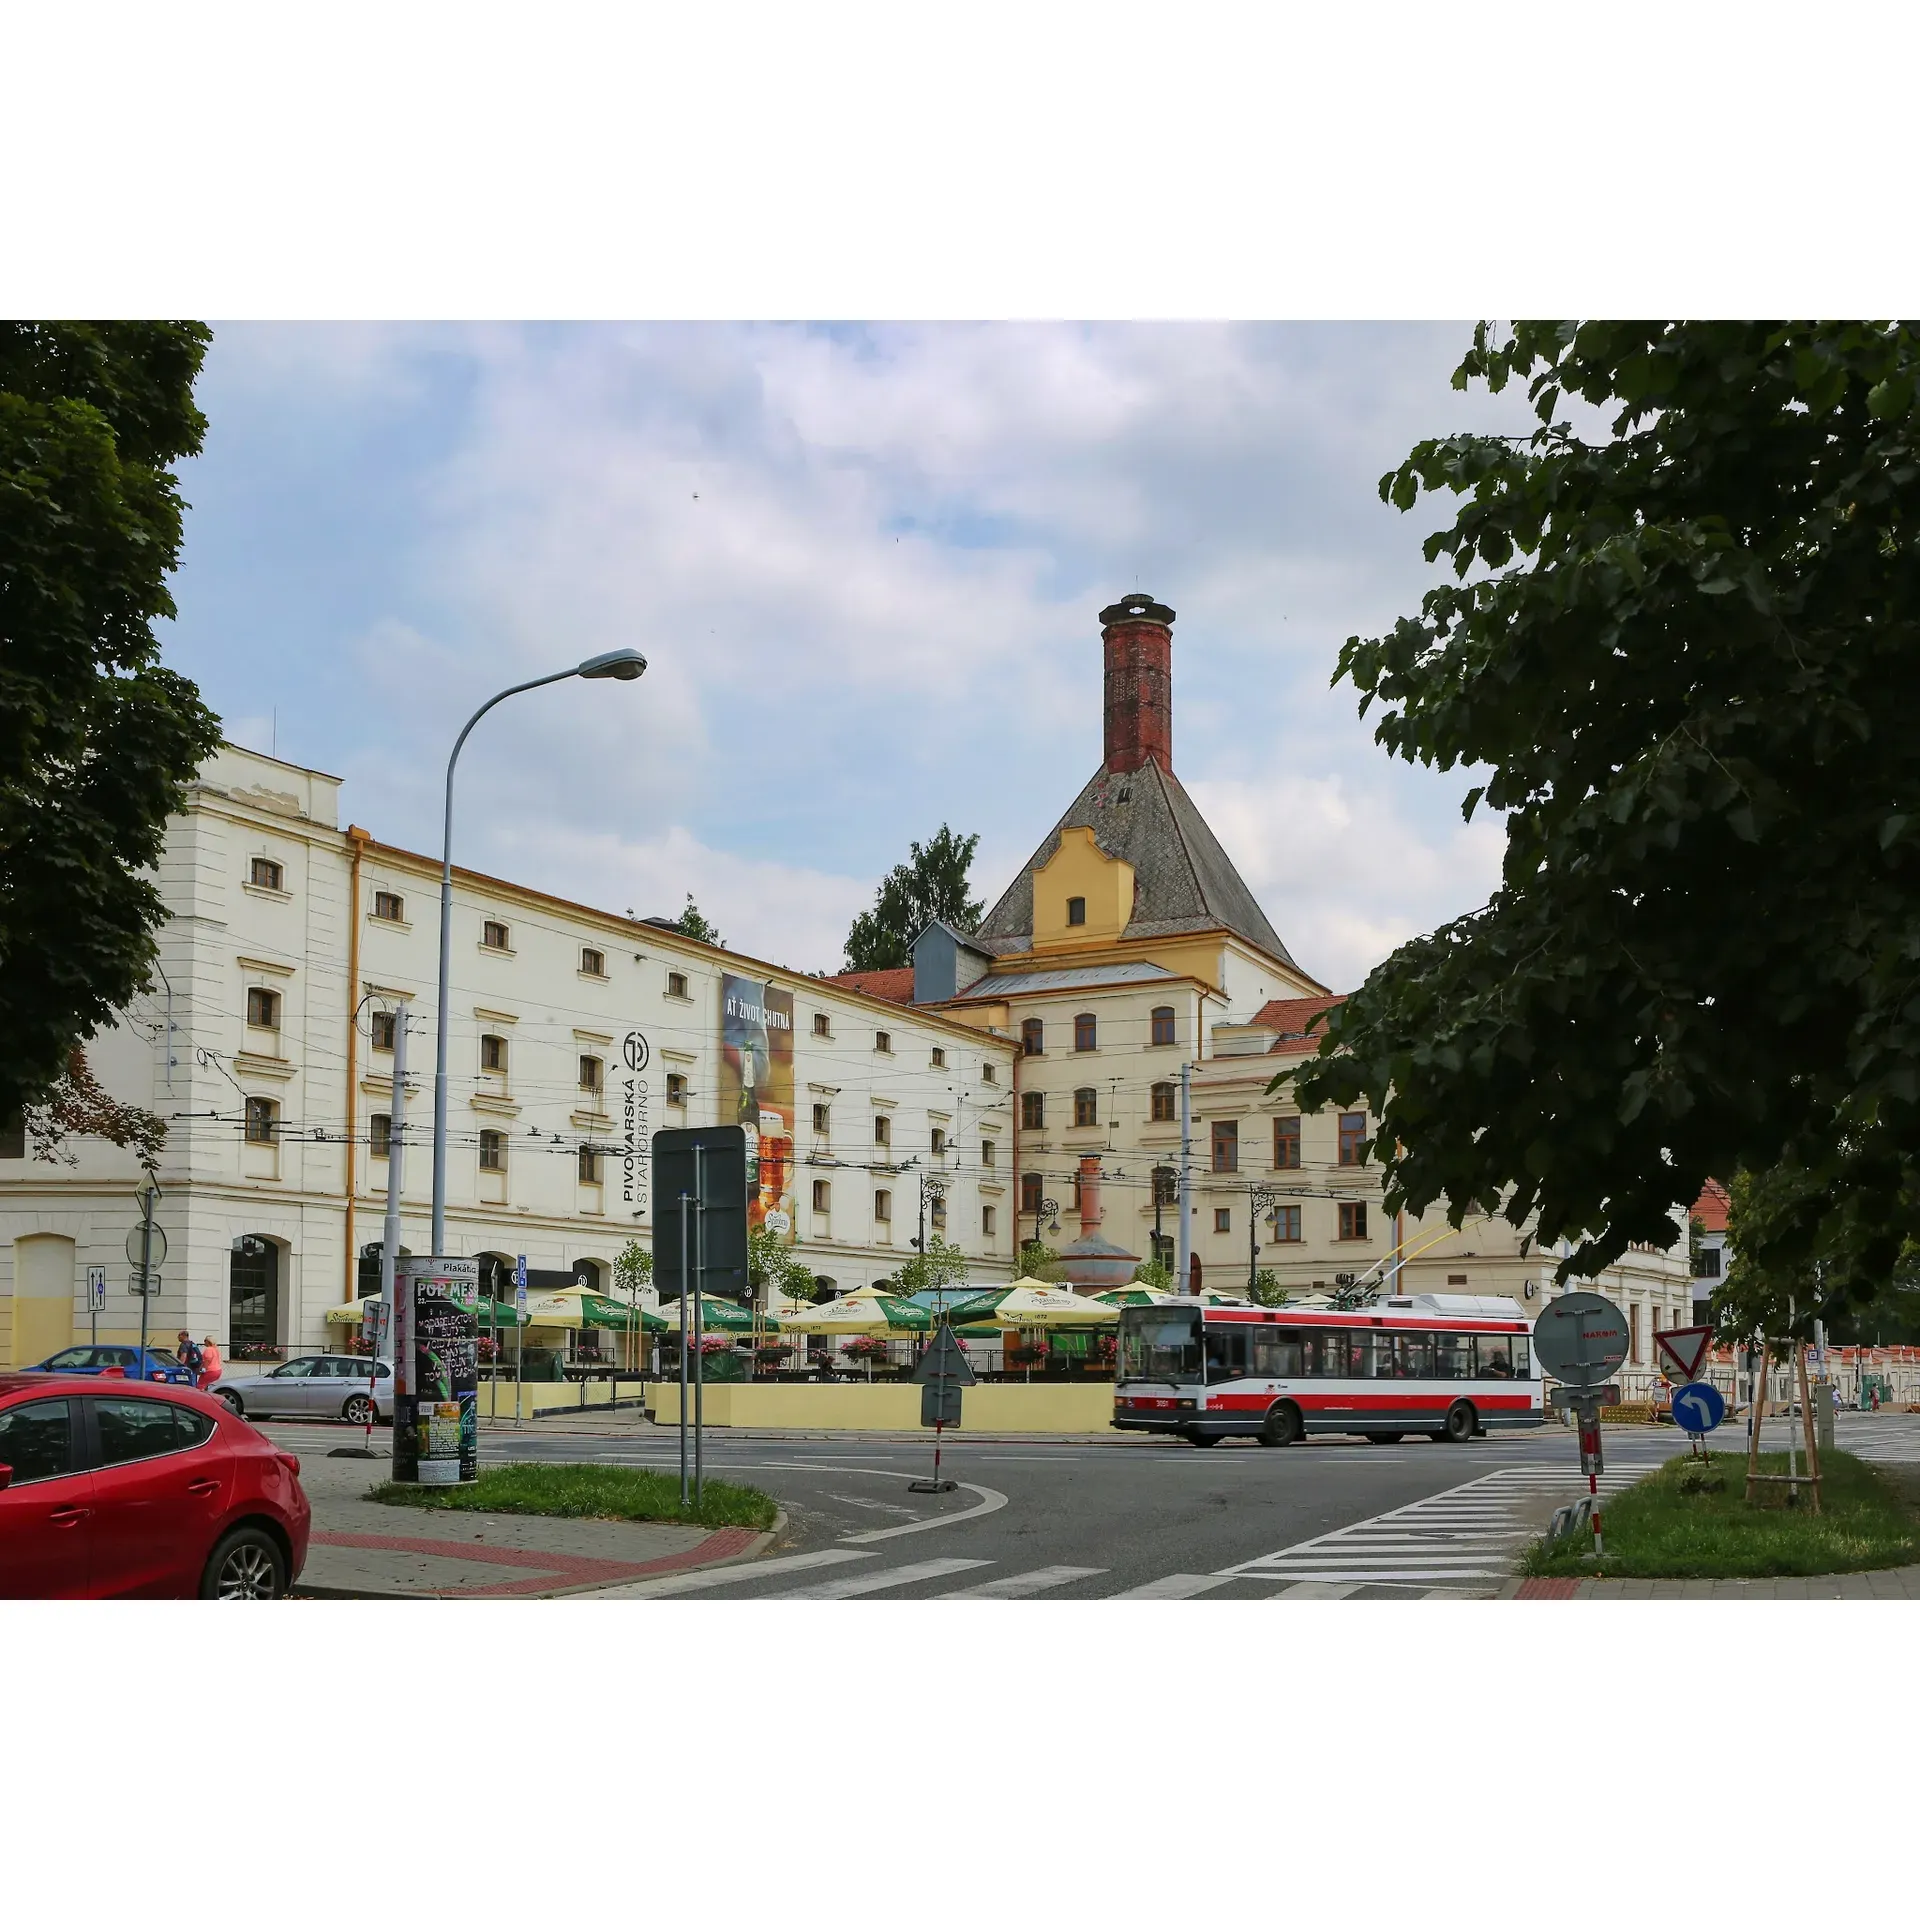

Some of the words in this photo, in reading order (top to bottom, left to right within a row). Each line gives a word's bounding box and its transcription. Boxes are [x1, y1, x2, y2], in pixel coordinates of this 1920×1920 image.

[726, 995, 737, 1017] AŤ
[739, 998, 760, 1023] ŽIVOT
[762, 1006, 790, 1030] CHUTNÁ
[621, 1078, 635, 1203] PIVOVARSKÁ
[637, 1079, 649, 1204] STAROBRNO
[417, 1283, 446, 1297] POP
